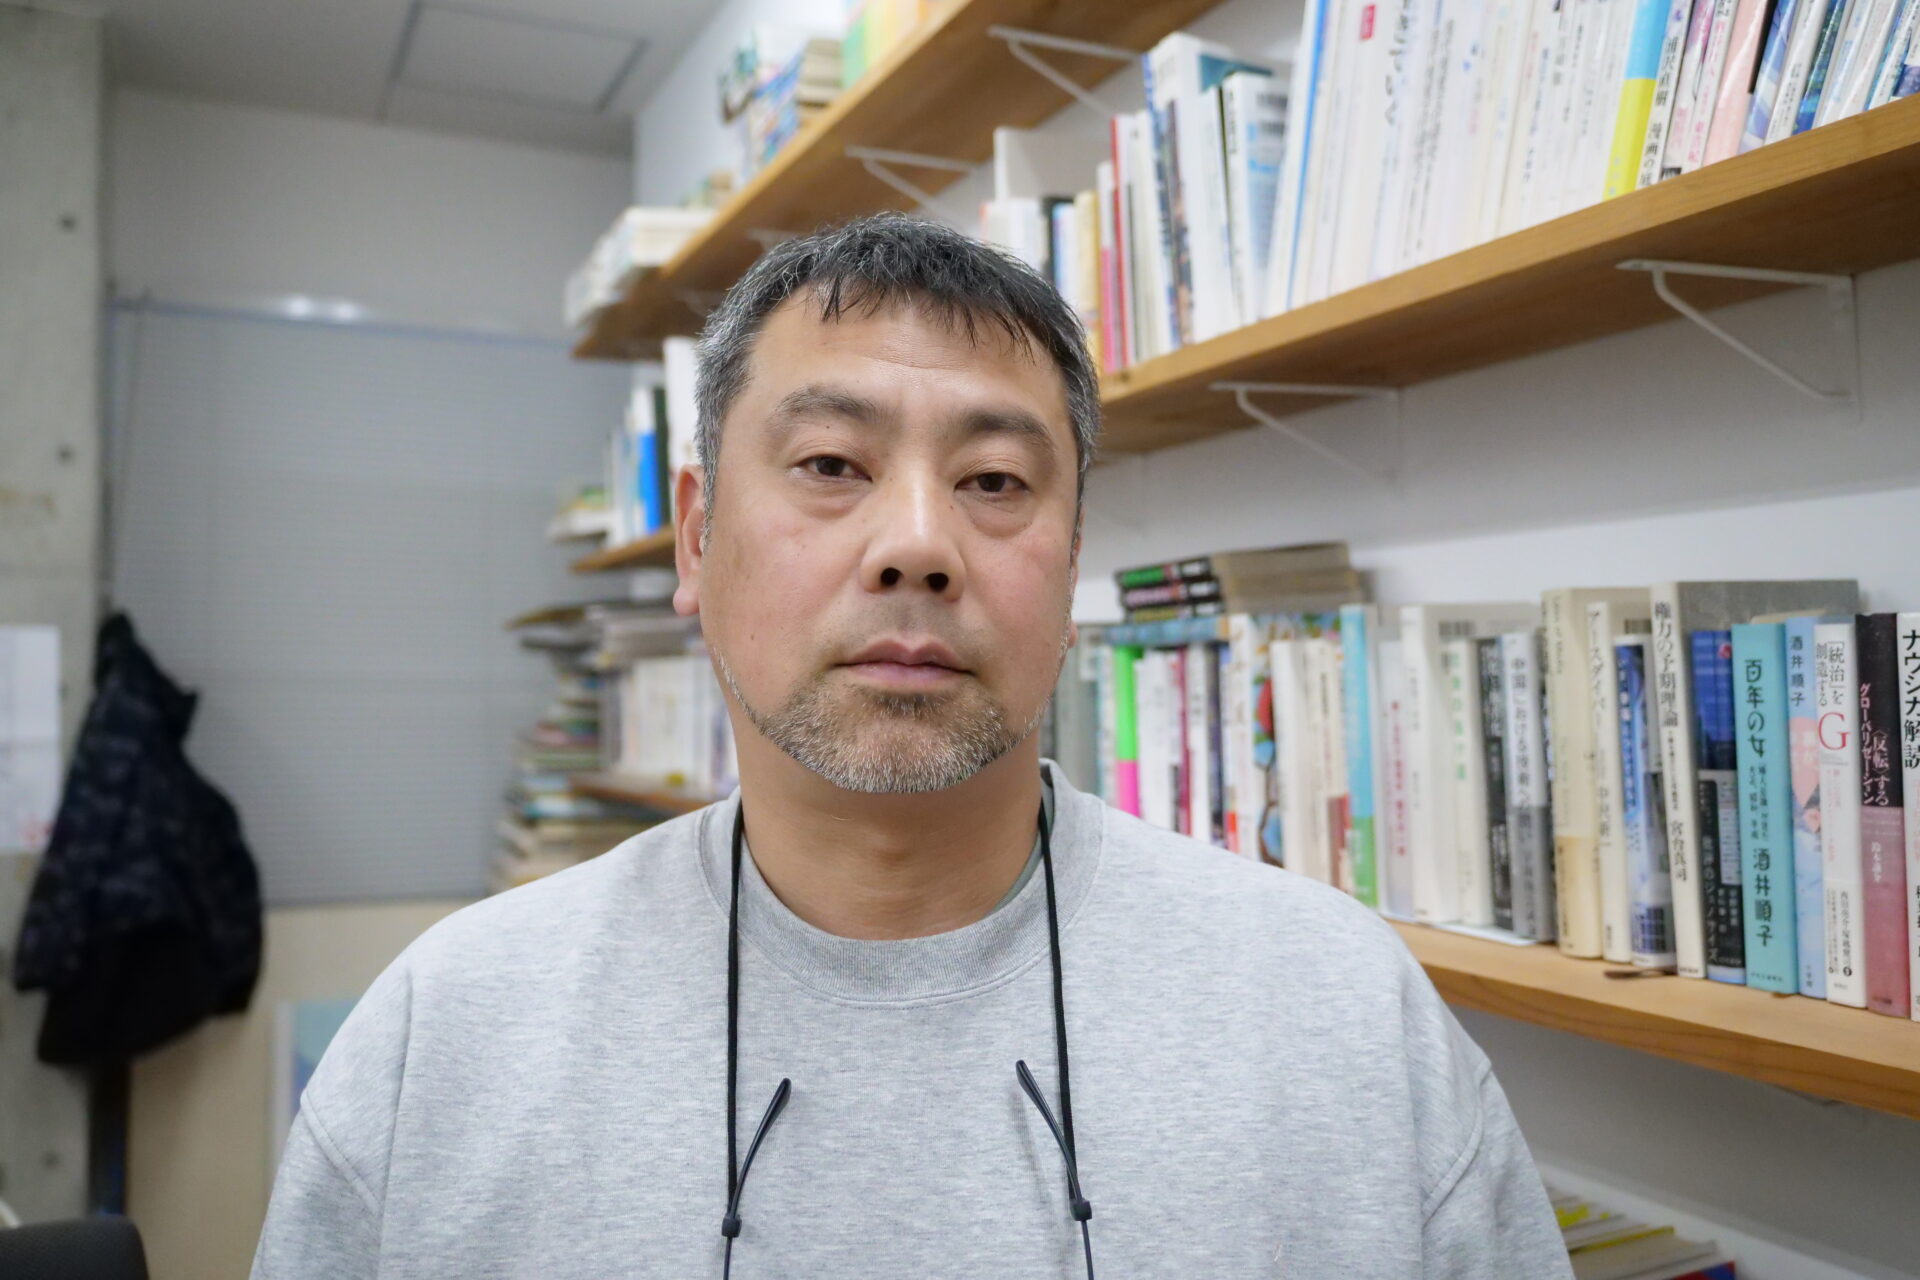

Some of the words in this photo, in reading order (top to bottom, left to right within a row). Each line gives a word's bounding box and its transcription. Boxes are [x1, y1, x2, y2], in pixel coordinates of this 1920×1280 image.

[1744, 658, 1766, 758] 百年の女
[1789, 635, 1805, 707] 酒井順子
[1818, 712, 1851, 751] G
[1860, 682, 1875, 805] グローバリゼーション
[1752, 847, 1773, 948] 酒井順子
